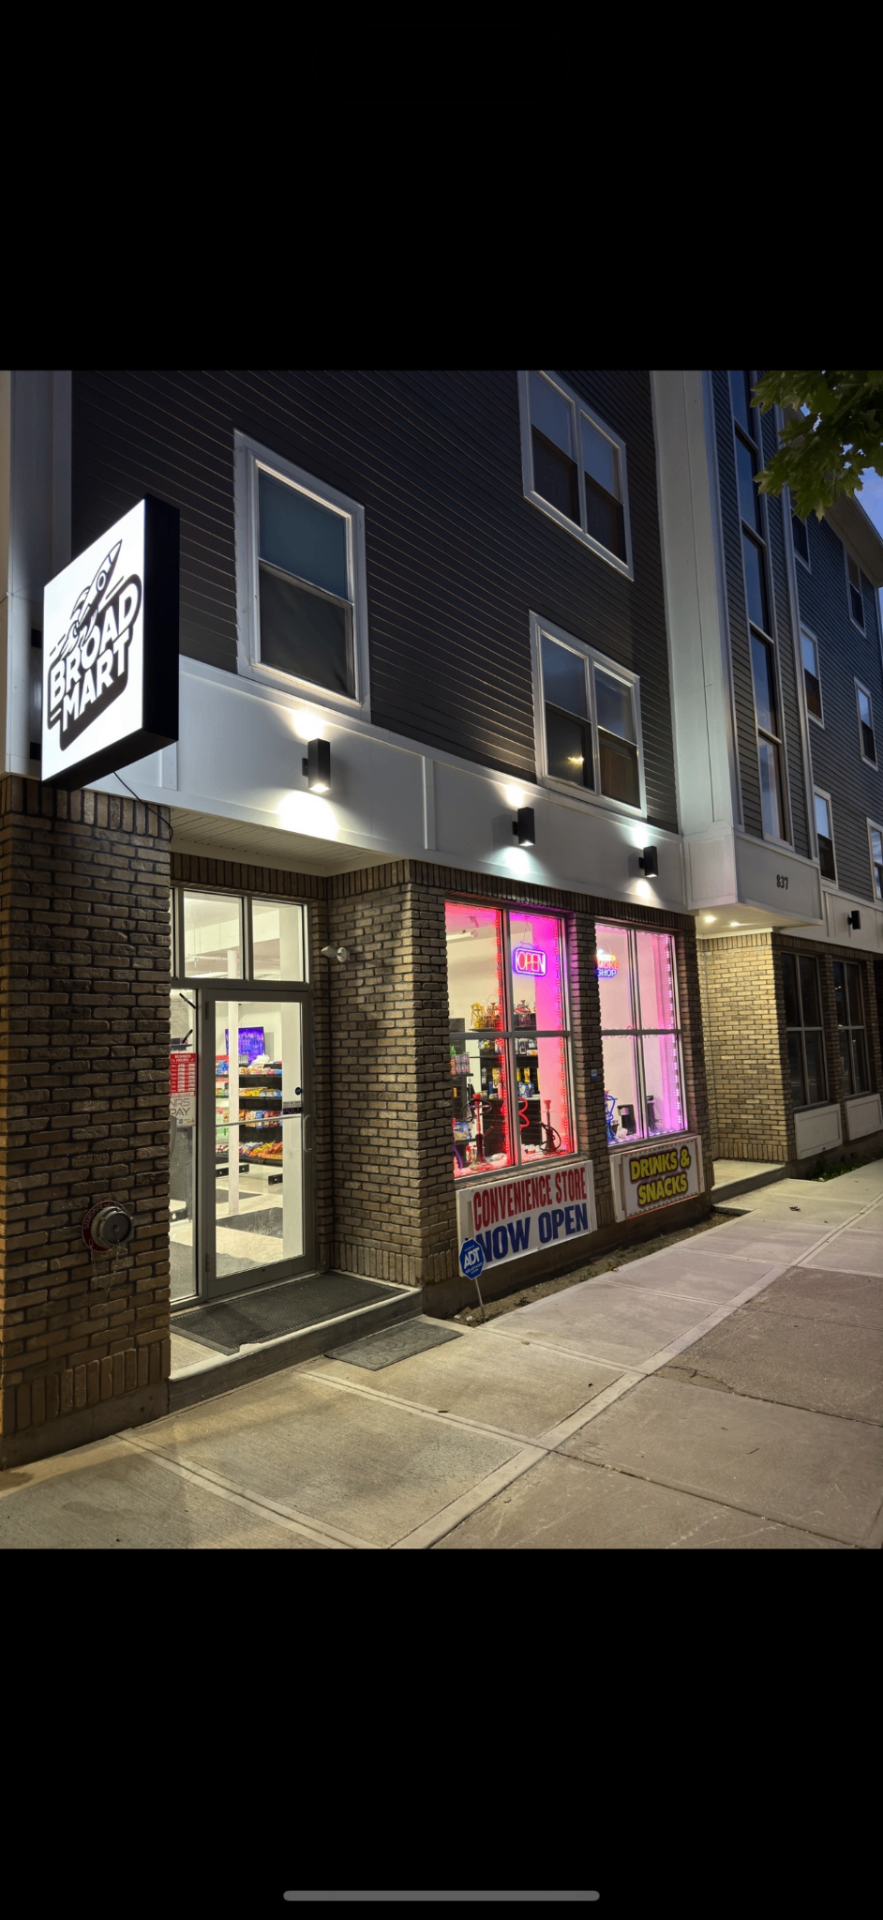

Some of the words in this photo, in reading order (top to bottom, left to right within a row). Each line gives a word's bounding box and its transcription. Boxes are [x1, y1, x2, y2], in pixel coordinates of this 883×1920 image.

[50, 582, 139, 713] BROAD
[62, 627, 130, 733] MART
[776, 873, 789, 890] 837
[517, 951, 546, 972] OPEN
[597, 960, 620, 970] MOKE
[630, 1150, 678, 1181] DRINKS
[680, 1147, 691, 1168] &
[473, 1174, 553, 1232] CONVENIENCE
[554, 1167, 587, 1204] STORE
[638, 1173, 688, 1205] SNACKS
[475, 1216, 531, 1263] NOW
[538, 1202, 589, 1244] OPEN
[463, 1246, 480, 1270] ADT
